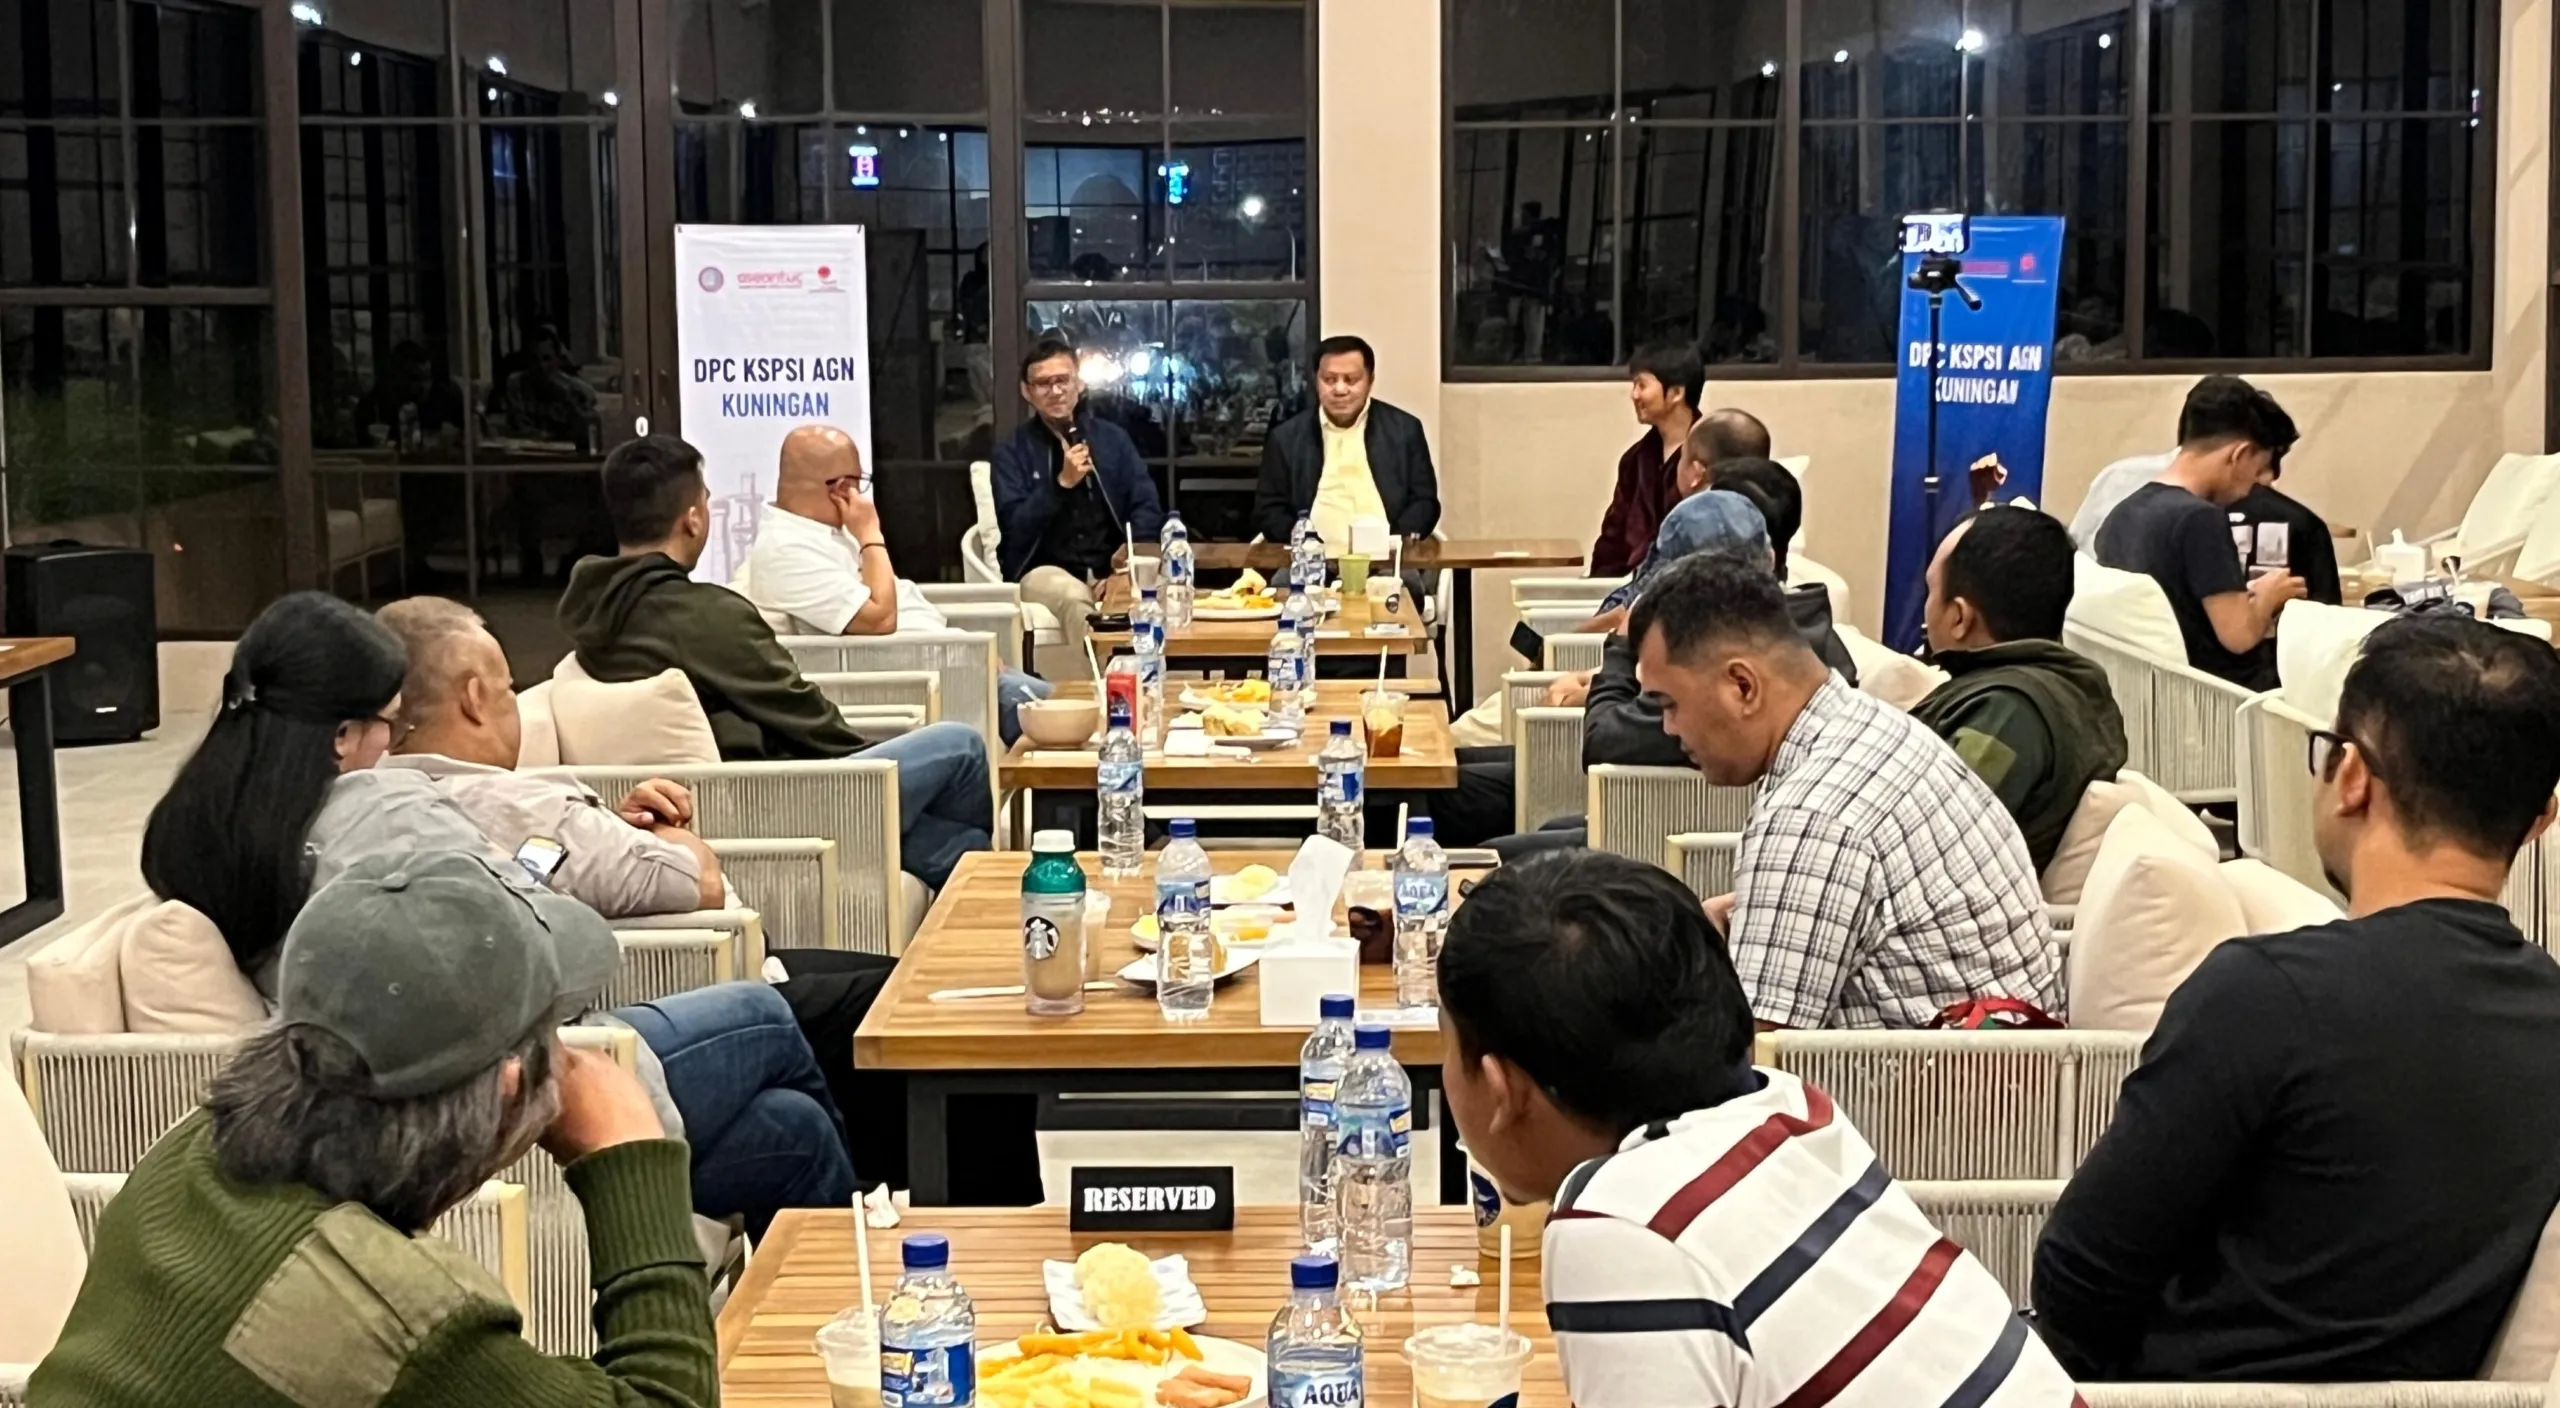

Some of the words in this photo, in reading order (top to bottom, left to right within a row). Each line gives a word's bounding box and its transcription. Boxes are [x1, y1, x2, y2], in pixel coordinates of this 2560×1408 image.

[694, 358, 736, 383] DPC
[743, 358, 804, 383] KSPSI
[812, 357, 855, 382] AGN
[1949, 344, 2003, 371] KSPSI
[722, 392, 829, 417] KUNINGAN
[1083, 1186, 1216, 1212] RESERVED
[1303, 1379, 1359, 1407] AQUA
